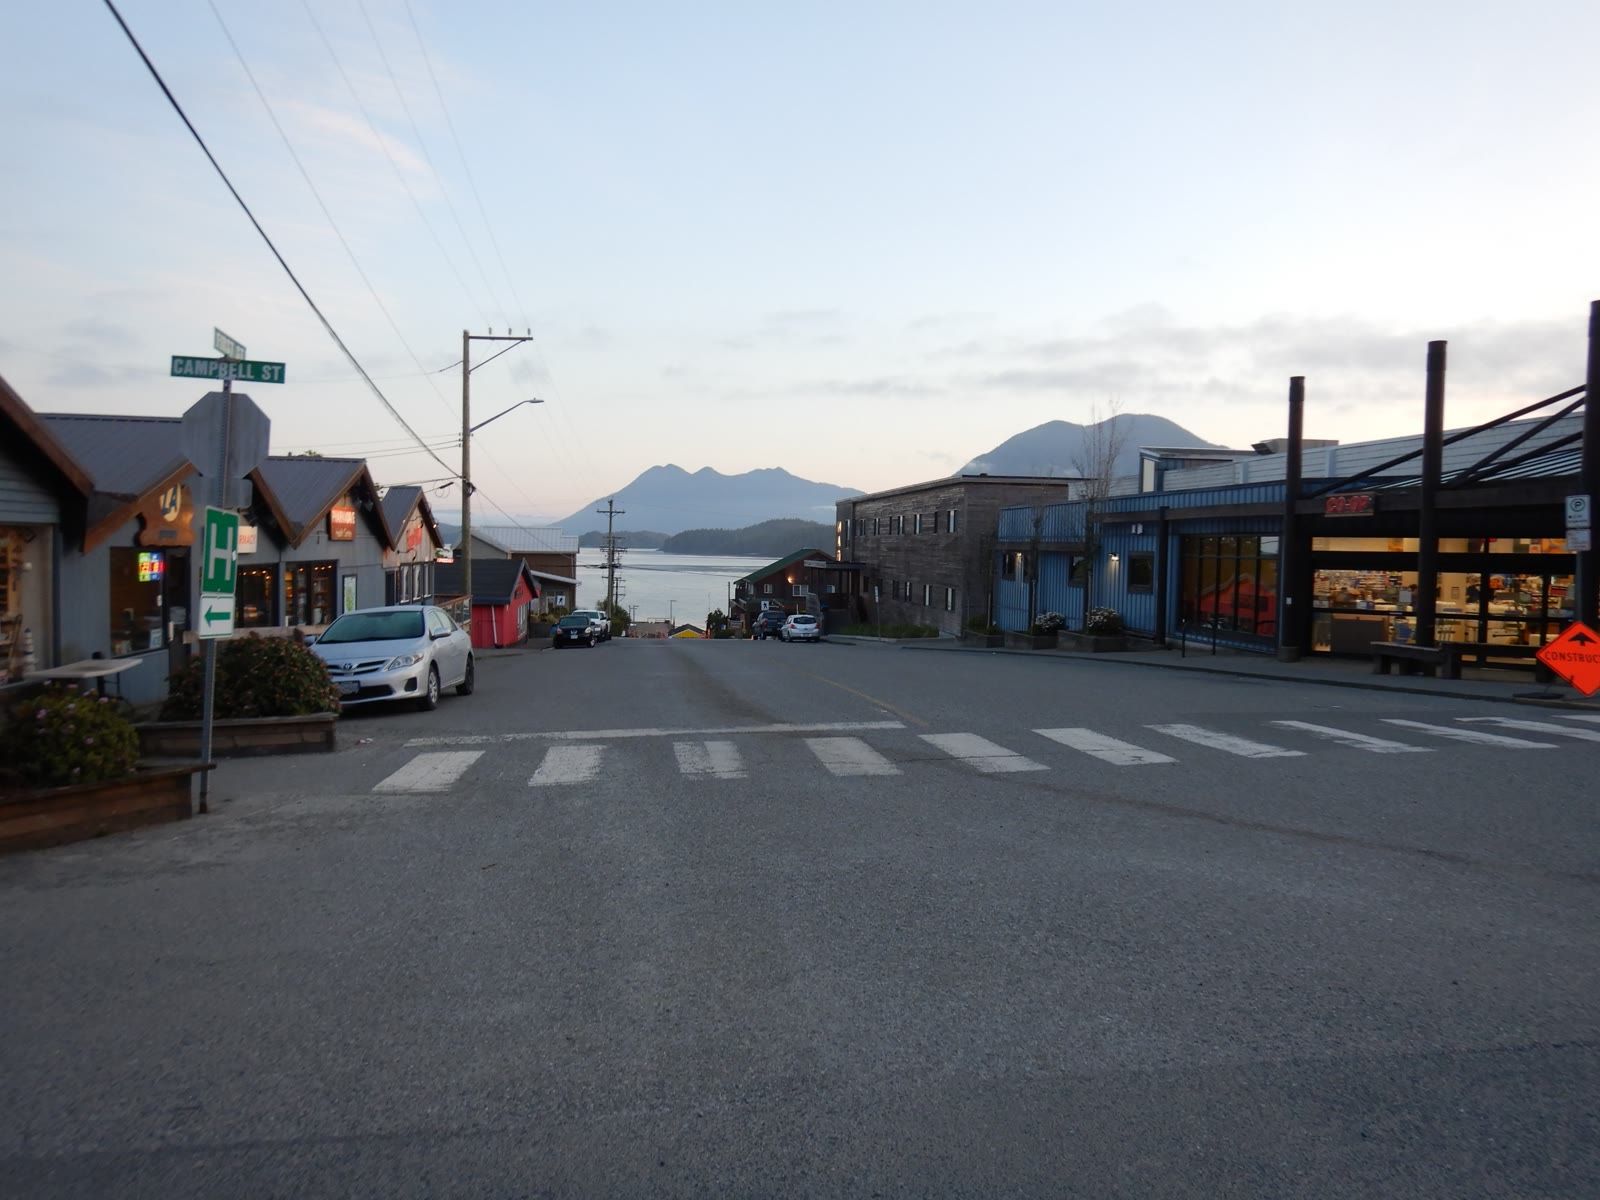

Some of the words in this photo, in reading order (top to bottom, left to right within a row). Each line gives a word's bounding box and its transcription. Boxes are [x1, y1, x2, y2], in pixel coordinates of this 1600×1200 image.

[173, 358, 254, 378] CAMPBELL
[261, 364, 282, 380] ST
[238, 534, 256, 545] RMACY
[208, 522, 233, 581] H
[1545, 651, 1600, 663] CONSTRUC
